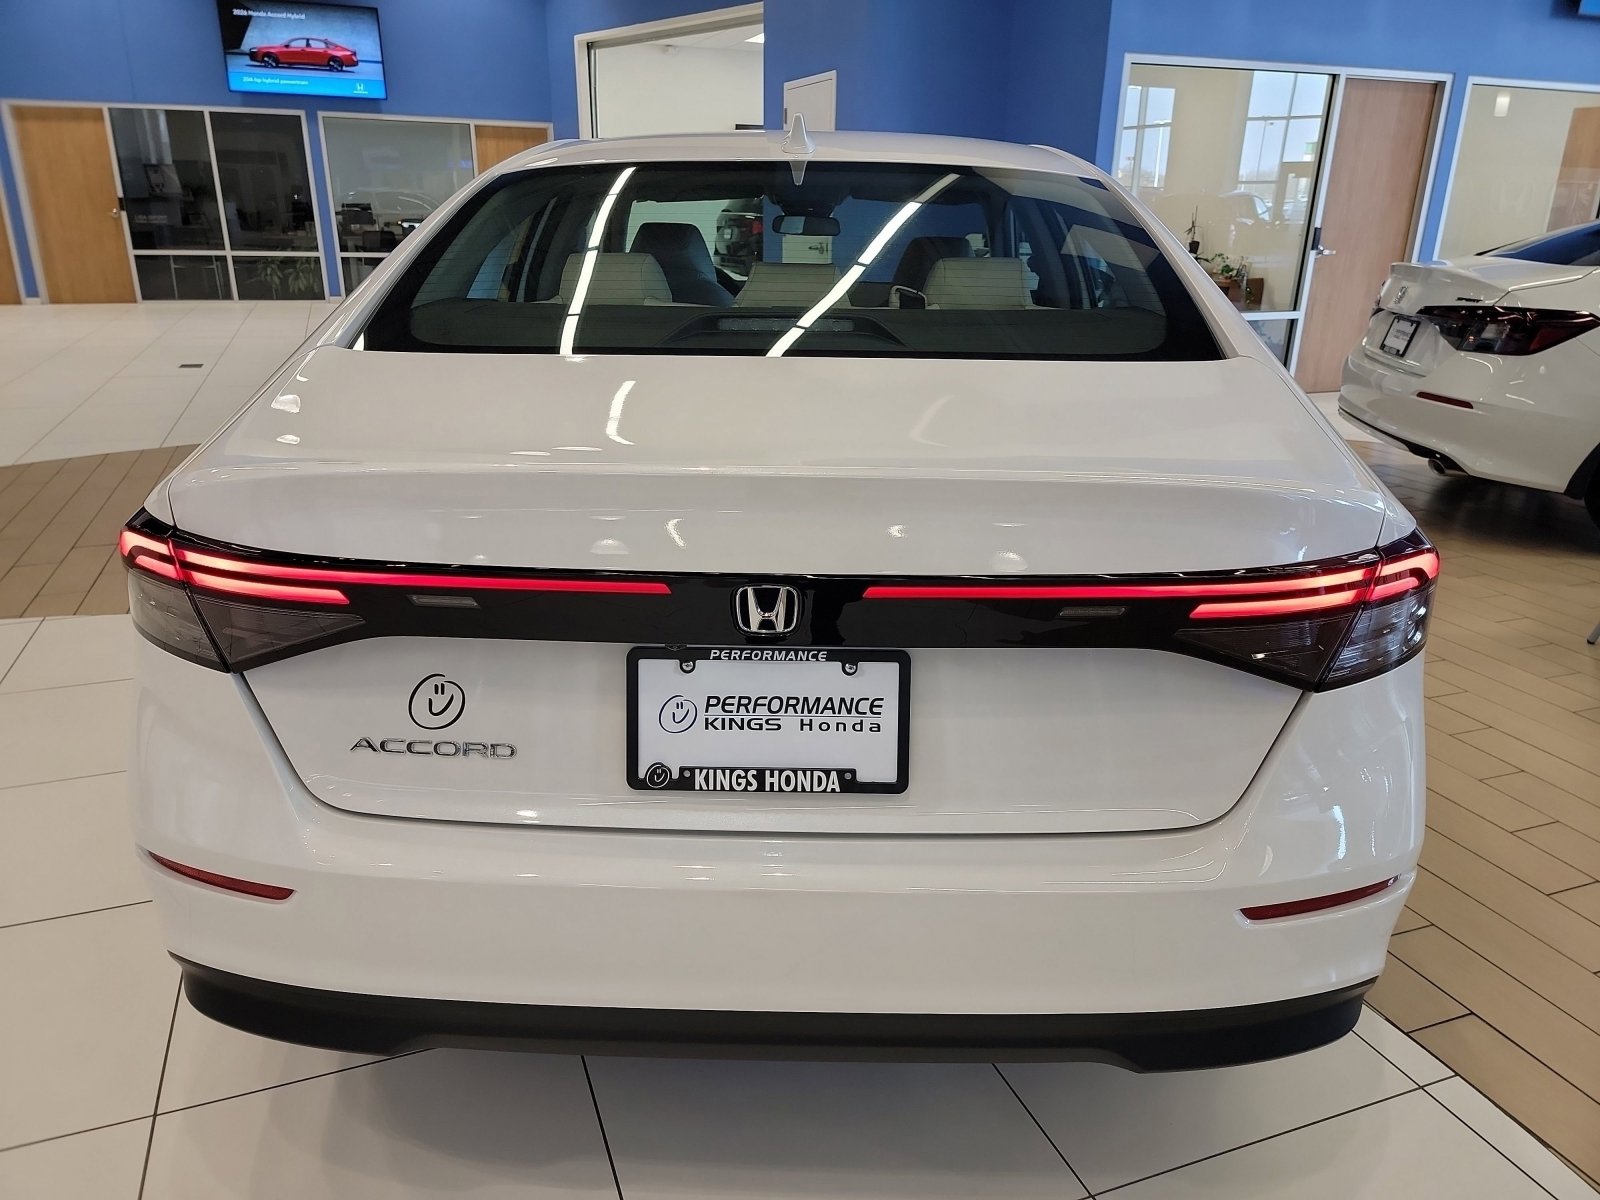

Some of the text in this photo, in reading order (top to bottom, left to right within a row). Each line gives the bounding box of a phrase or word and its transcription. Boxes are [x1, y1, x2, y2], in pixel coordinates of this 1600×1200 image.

[709, 650, 828, 662] PERFORMANCE
[704, 695, 885, 716] PERFORMANCE
[704, 717, 882, 733] KINGS Honda
[350, 737, 518, 760] ACCORD
[694, 768, 841, 793] KINGS HONDA
